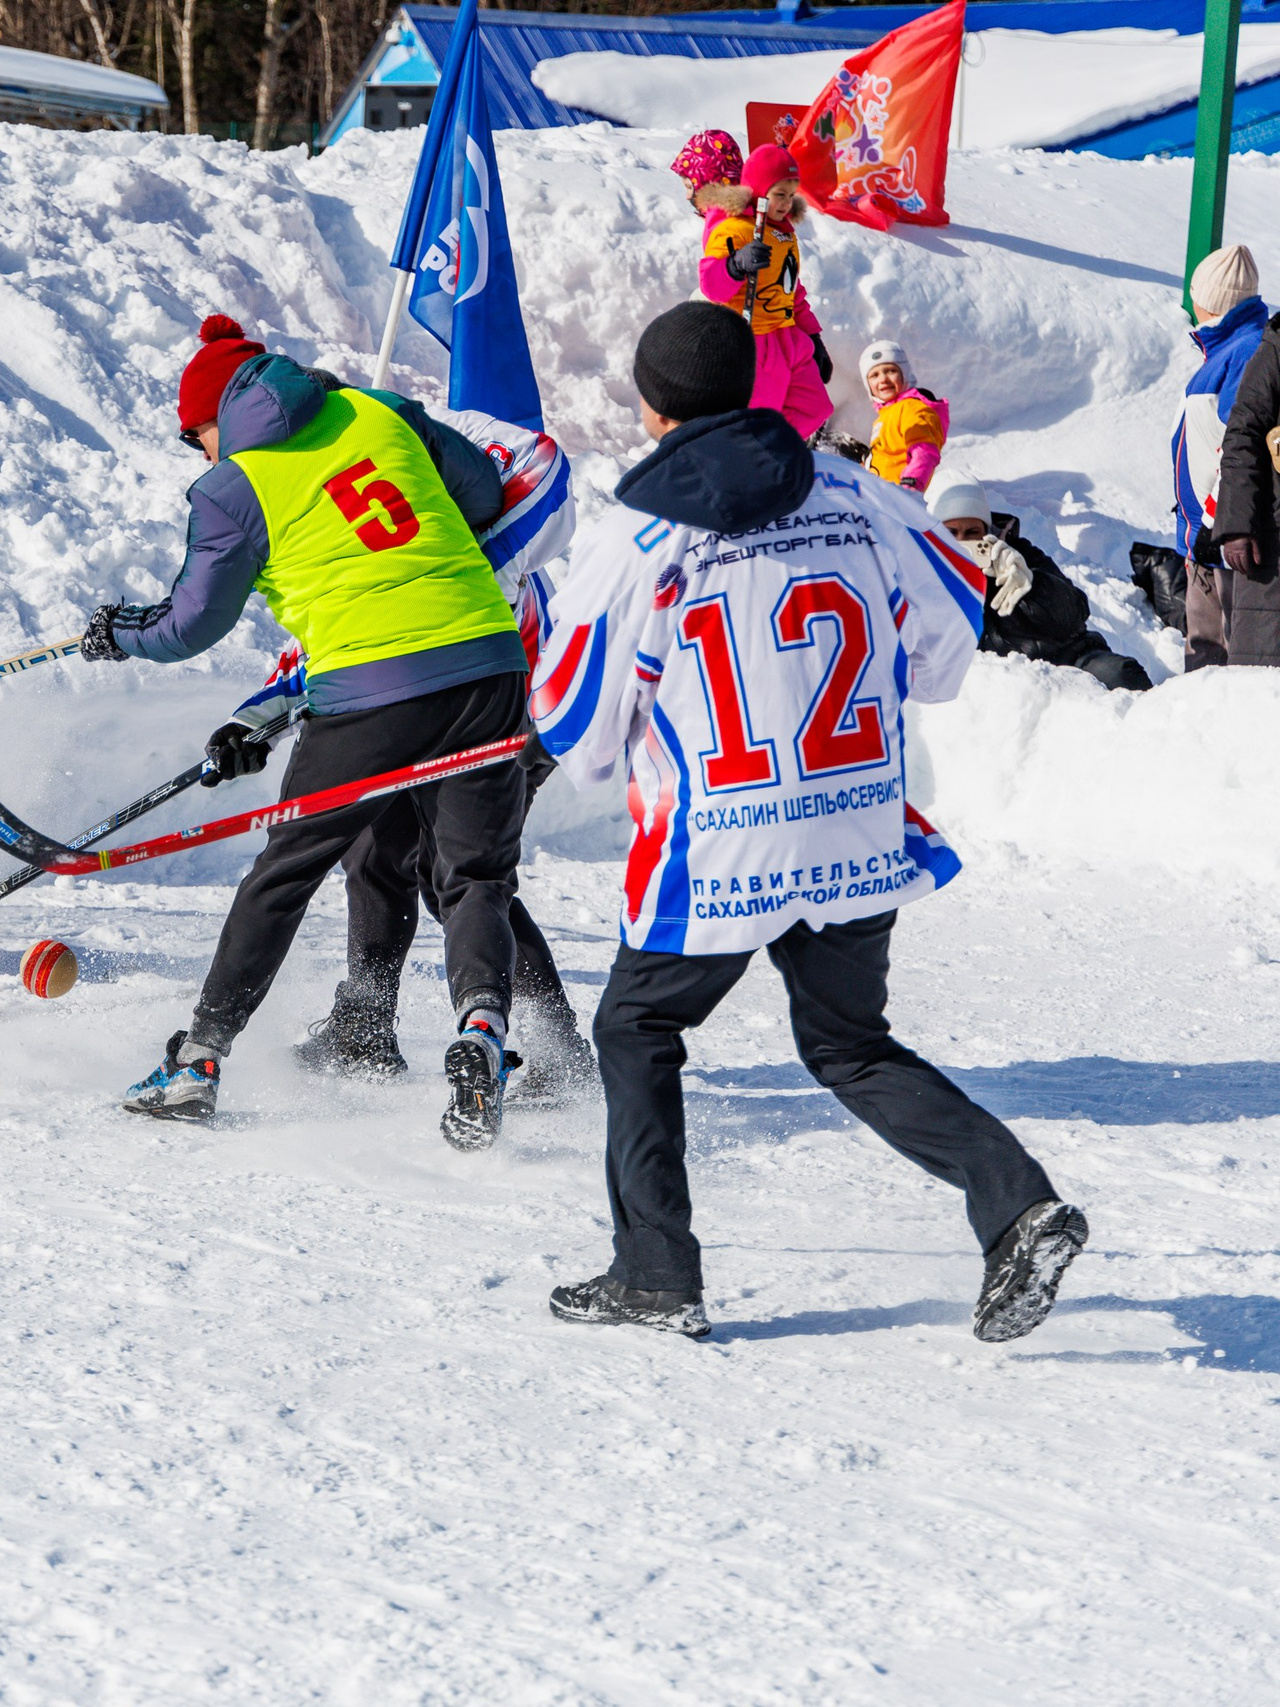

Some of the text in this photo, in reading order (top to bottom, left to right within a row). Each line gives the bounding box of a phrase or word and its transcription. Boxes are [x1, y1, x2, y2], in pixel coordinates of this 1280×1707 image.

[322, 457, 420, 553] 5
[677, 571, 890, 796] 12
[412, 754, 458, 772] LEAGUE
[459, 741, 508, 759] HOCKEY
[394, 761, 485, 790] CHAMPION
[250, 804, 306, 832] NHL
[66, 821, 110, 850] SCHER
[126, 851, 149, 863] NHL
[695, 883, 841, 919] САХАЛИНСКОЙ
